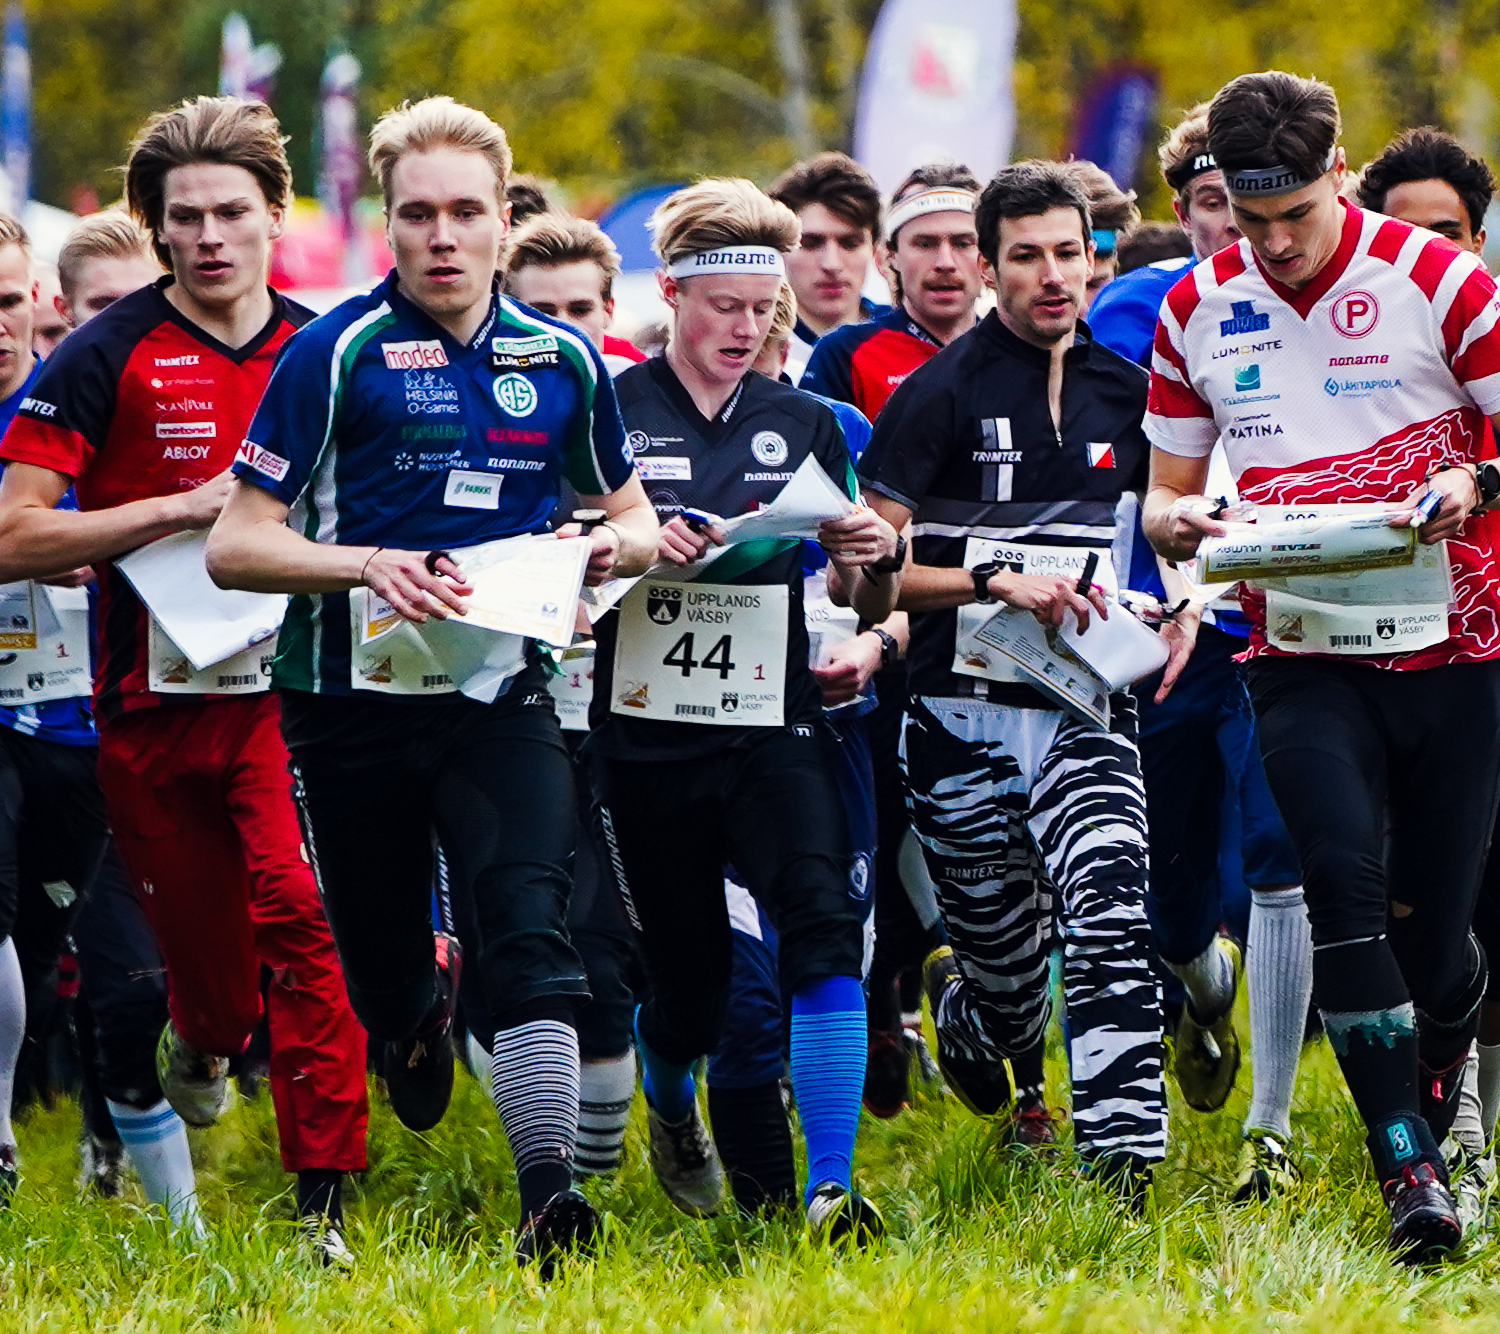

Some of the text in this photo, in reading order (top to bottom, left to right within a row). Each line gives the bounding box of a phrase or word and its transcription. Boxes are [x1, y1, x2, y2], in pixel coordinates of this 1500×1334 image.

[1228, 172, 1297, 190] nonam
[696, 252, 775, 265] noname
[1346, 300, 1368, 328] P
[154, 355, 199, 366] TRIMTEX
[1329, 355, 1389, 366] noname
[406, 390, 459, 402] HELSINKI
[408, 402, 460, 414] O-Games
[162, 446, 210, 459] ABLOY
[973, 451, 1023, 462] TRIMTEX
[488, 458, 546, 471] noname
[744, 472, 796, 482] nonam
[688, 592, 761, 608] UPPLANDS
[687, 608, 733, 624] VÄSBY
[1398, 615, 1441, 626] UPPLANDS
[56, 642, 69, 658] 1
[663, 632, 766, 680] 44 1
[945, 866, 995, 880] TRIMTEX
